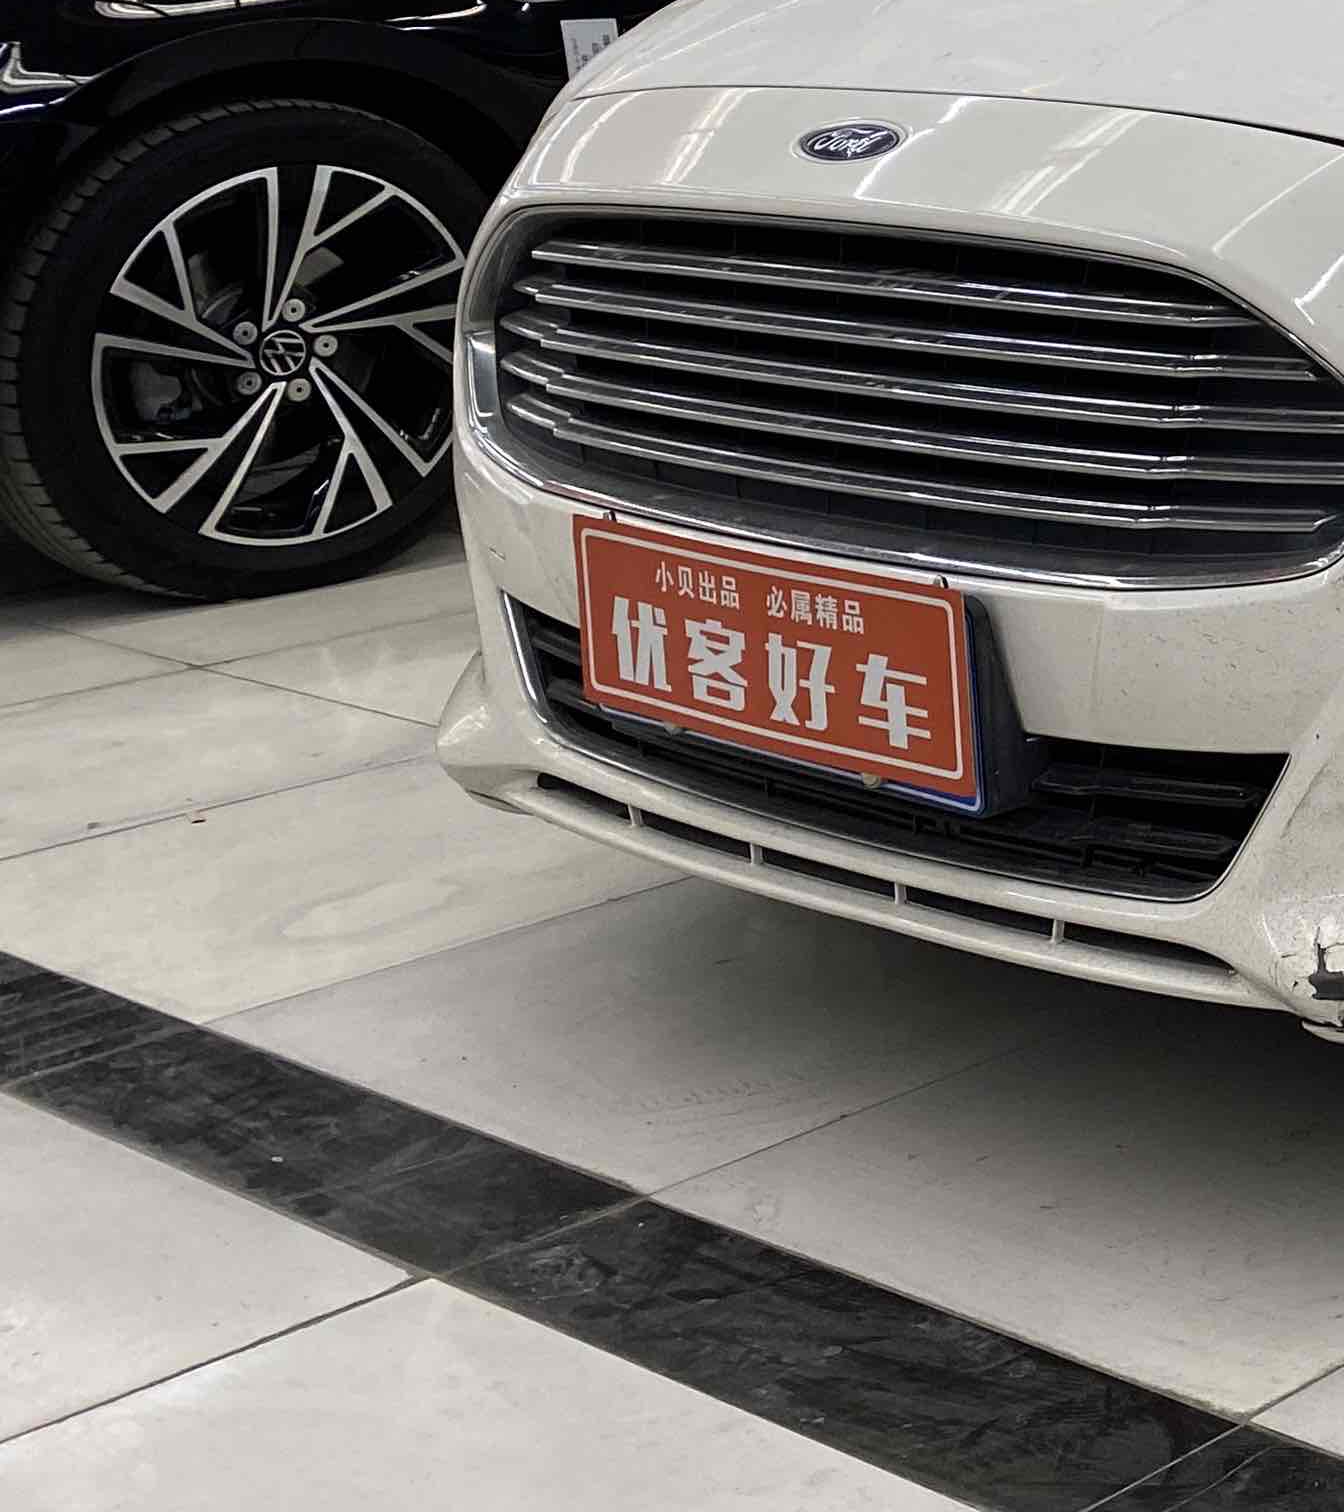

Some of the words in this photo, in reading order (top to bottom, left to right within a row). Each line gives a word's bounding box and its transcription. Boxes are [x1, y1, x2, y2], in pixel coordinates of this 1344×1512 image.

[807, 128, 888, 158] Ford
[655, 560, 741, 610] 小贝出品
[765, 585, 865, 635] 必属精品
[611, 595, 932, 750] 优客好车
